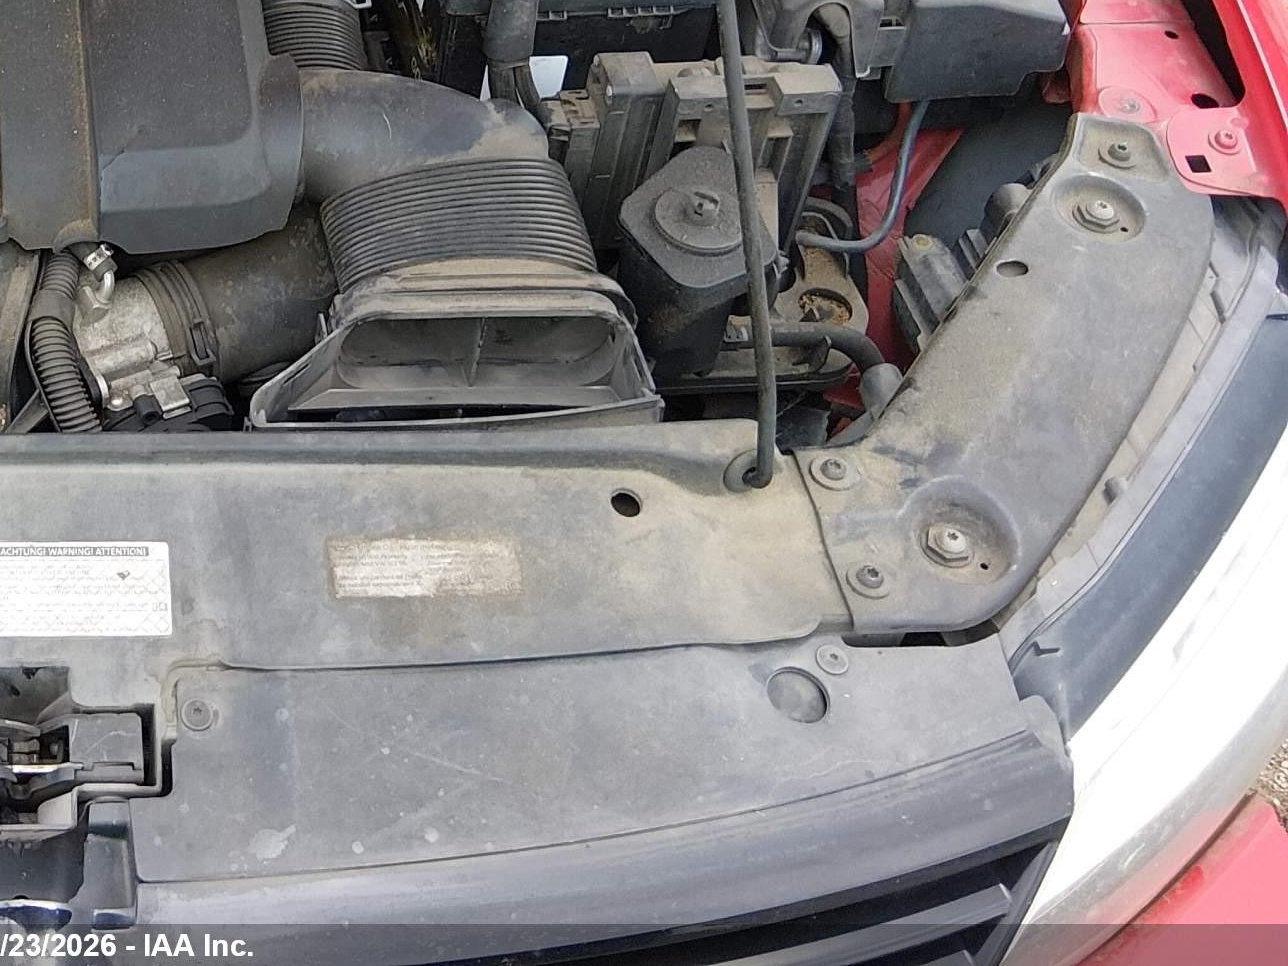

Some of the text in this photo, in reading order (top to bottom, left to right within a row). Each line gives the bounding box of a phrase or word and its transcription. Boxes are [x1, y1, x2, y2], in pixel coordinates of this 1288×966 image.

[0, 546, 147, 557] ACHTUNG! WARNING! ATTENTION!
